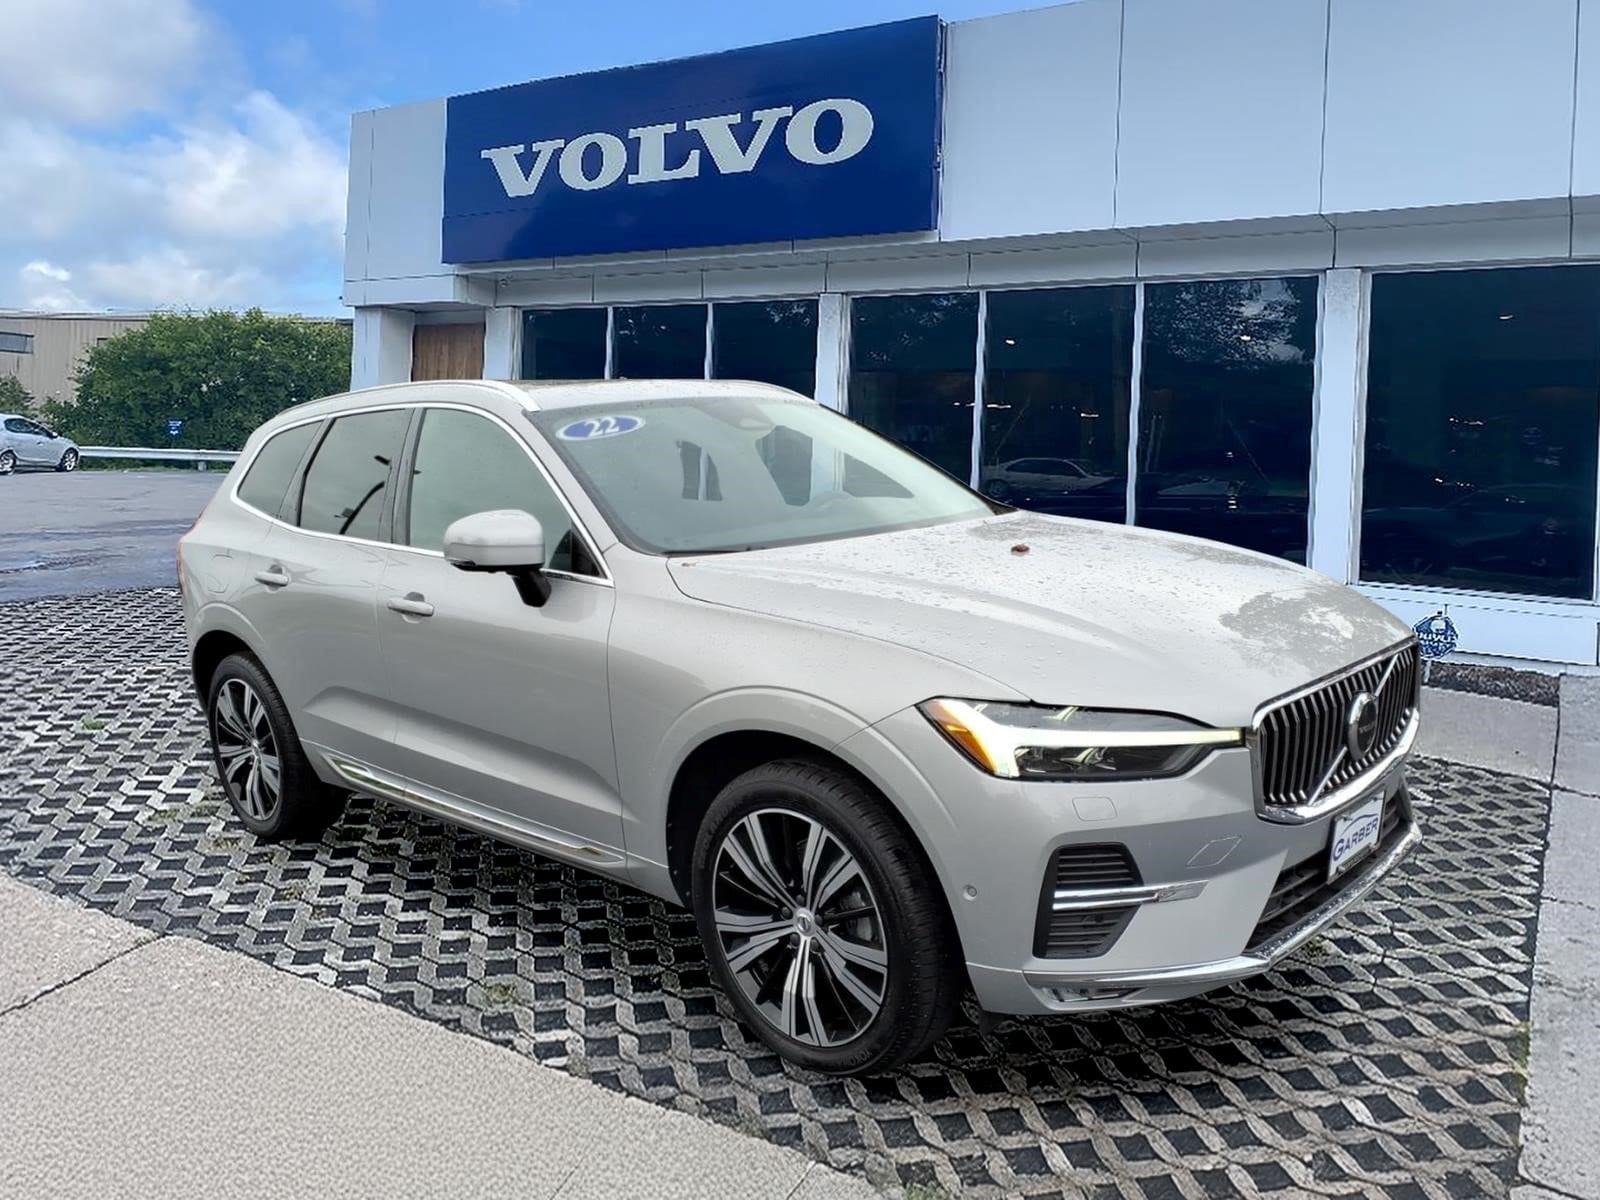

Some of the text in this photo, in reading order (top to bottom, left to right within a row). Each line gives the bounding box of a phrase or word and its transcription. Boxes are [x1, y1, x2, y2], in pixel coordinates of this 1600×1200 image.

[481, 98, 874, 198] VOLVO
[584, 416, 620, 437] 22
[1333, 817, 1379, 861] GARBER
